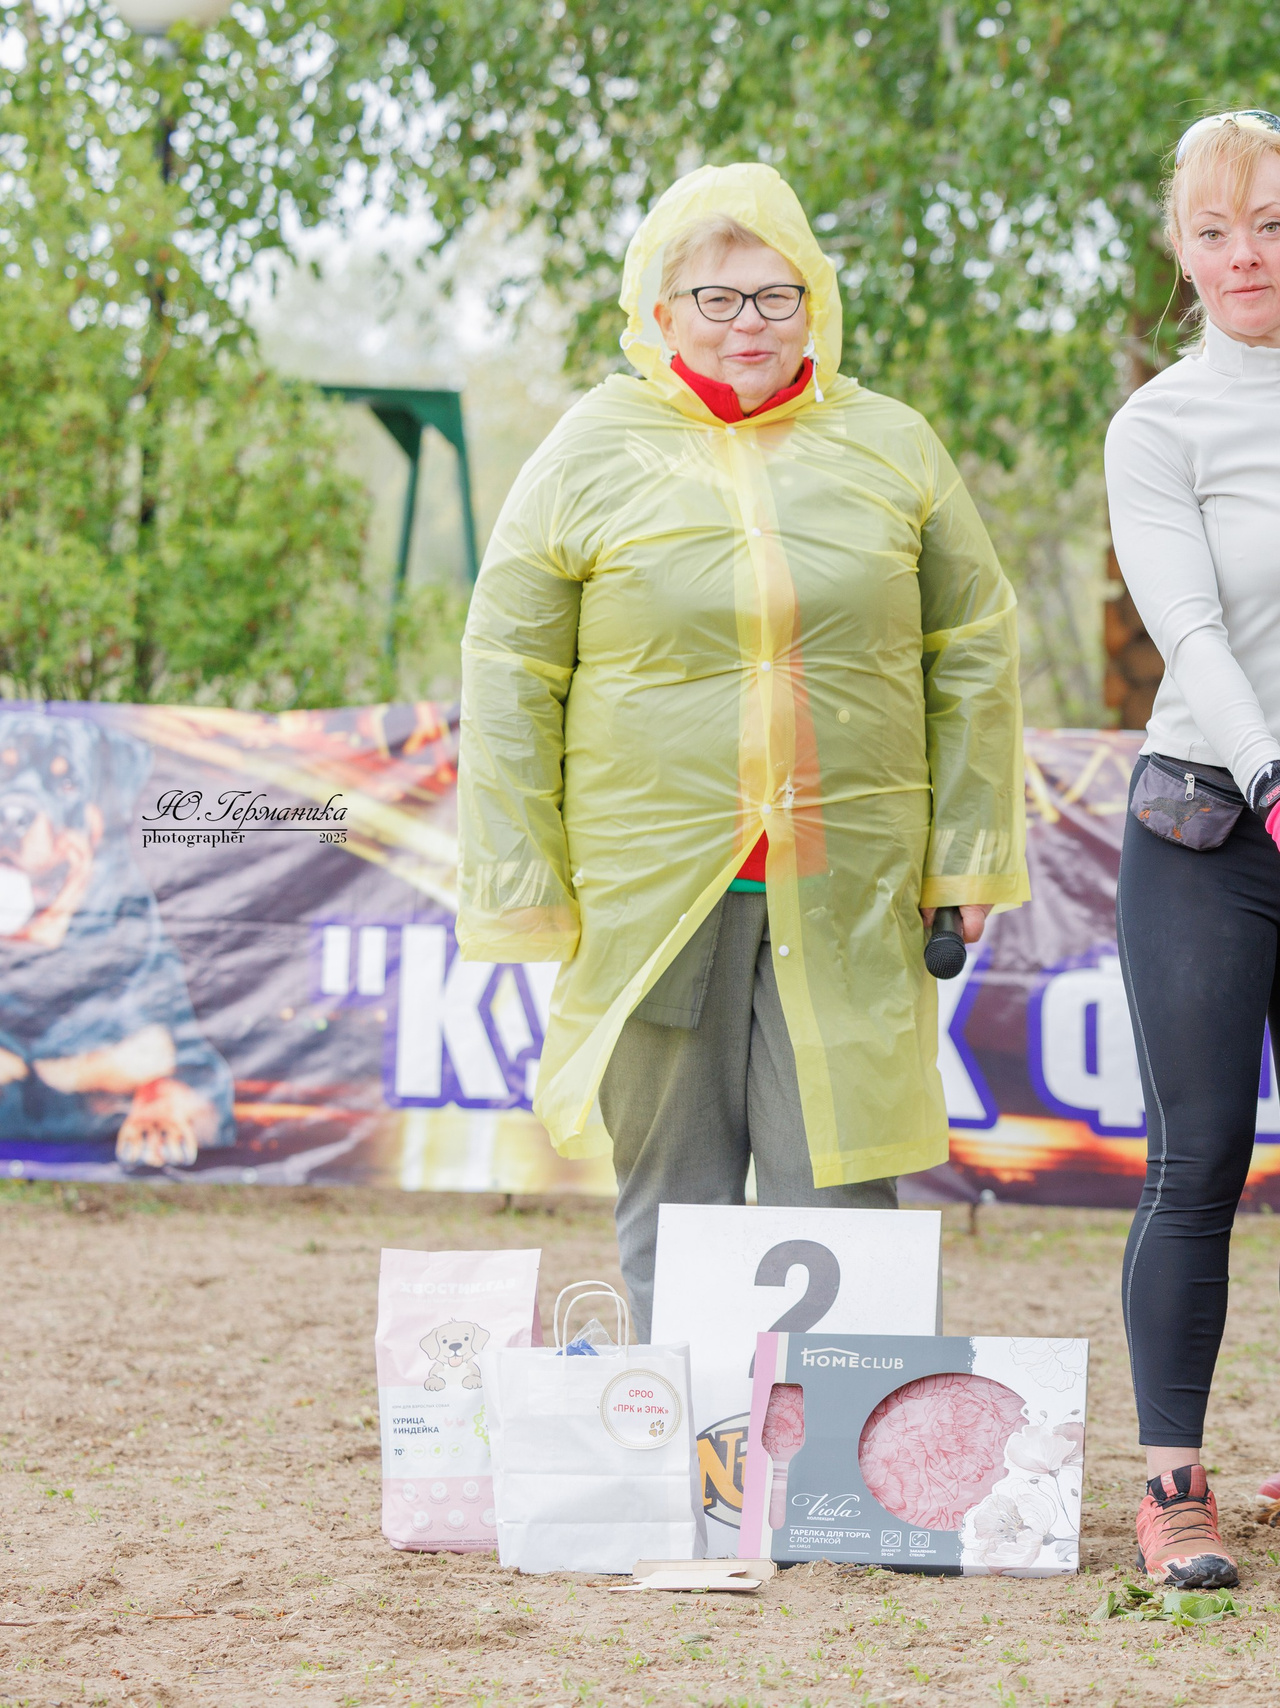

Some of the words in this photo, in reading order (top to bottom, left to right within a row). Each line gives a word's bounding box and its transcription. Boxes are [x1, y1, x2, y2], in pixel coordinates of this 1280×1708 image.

[749, 1239, 841, 1379] 2
[628, 1389, 654, 1399] СРОО
[791, 1493, 862, 1518] Viola
[789, 1528, 825, 1537] ТАРЕЛКА
[826, 1530, 845, 1539] ДЛЯ
[845, 1531, 871, 1539] ТОРТА
[796, 1536, 841, 1545] ЛОПАТКОЙ
